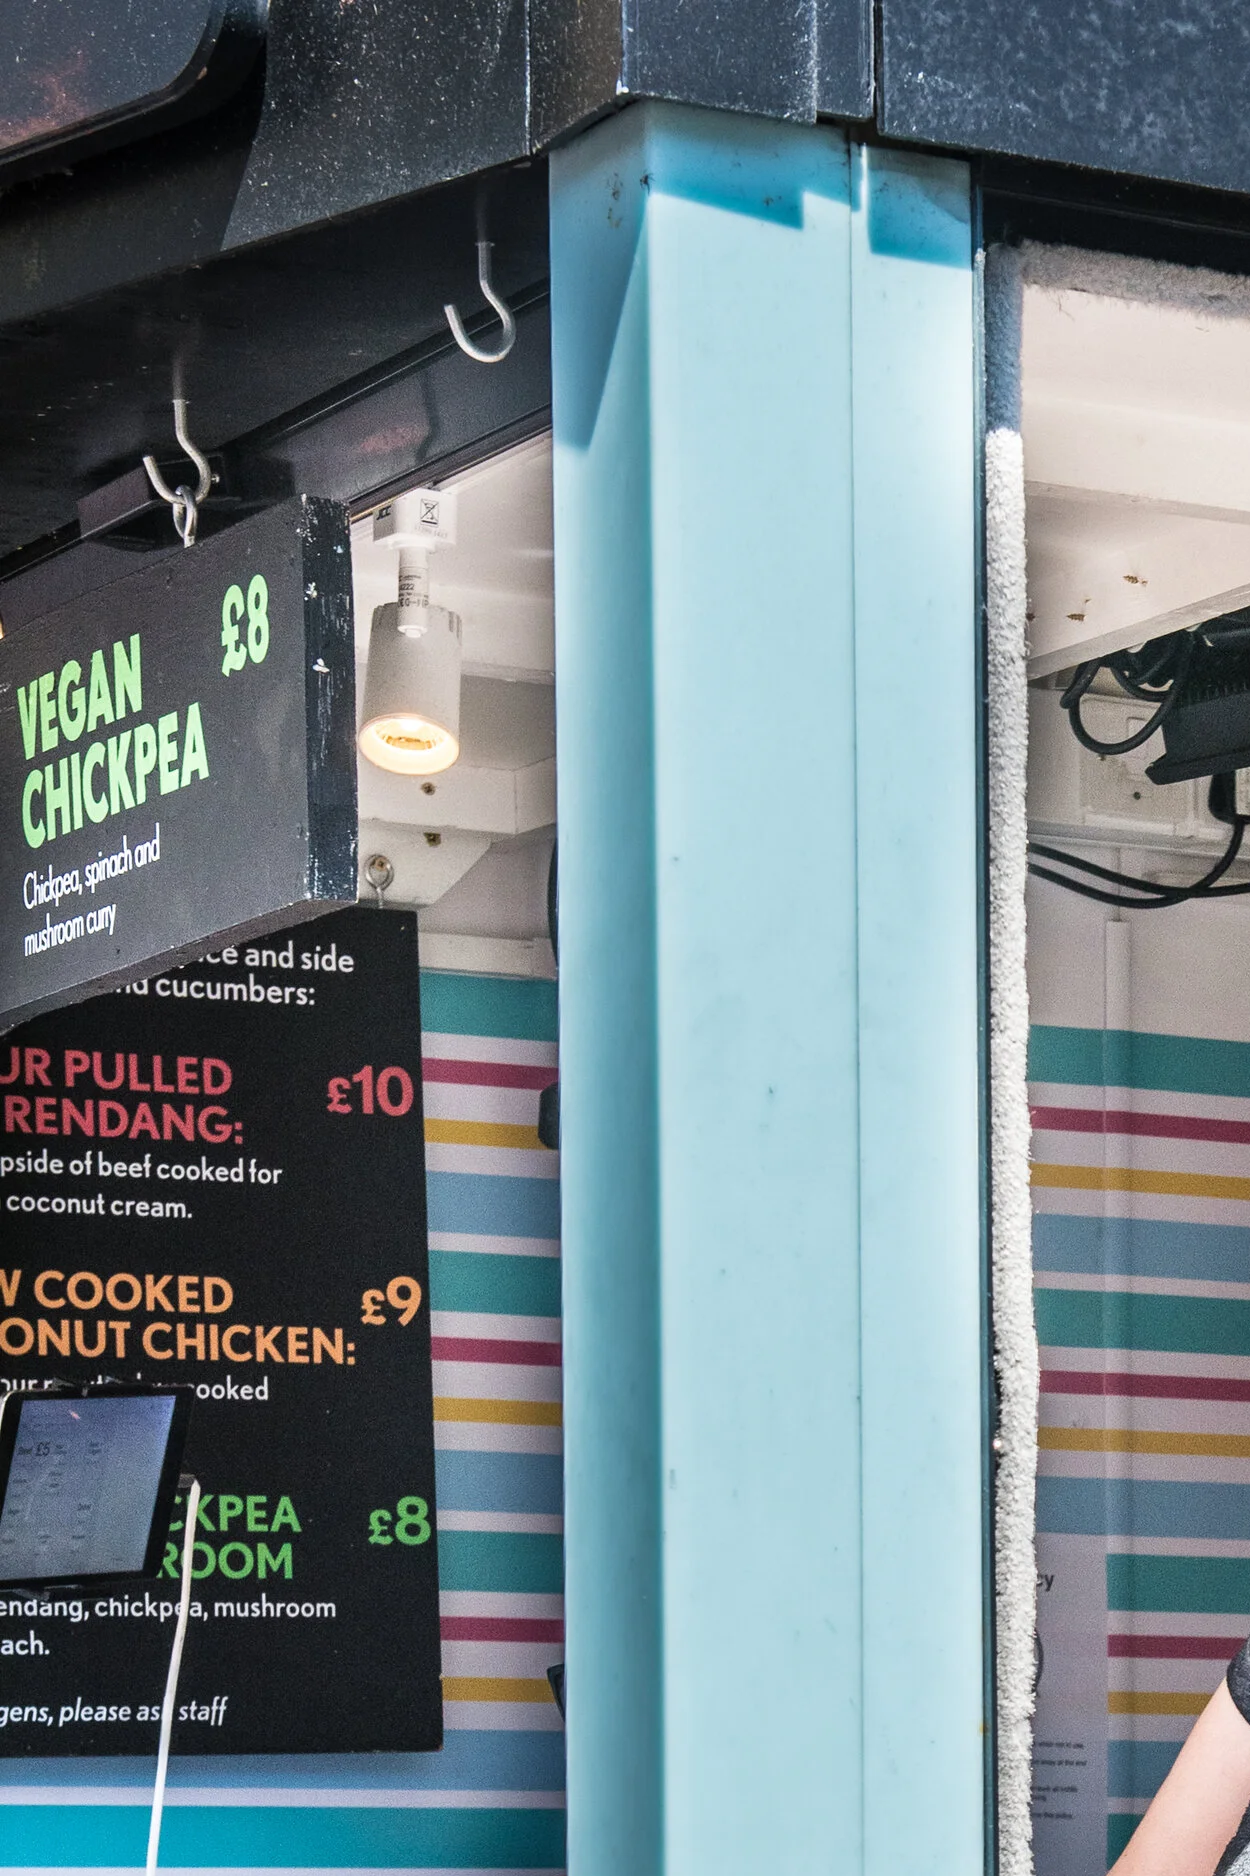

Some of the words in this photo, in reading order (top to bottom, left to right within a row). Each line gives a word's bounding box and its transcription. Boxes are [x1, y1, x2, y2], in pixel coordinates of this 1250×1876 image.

[221, 574, 269, 676] £8
[17, 634, 141, 760] VEGAN
[22, 703, 209, 849] CHICKPEA
[23, 864, 83, 910] Chickpea,
[84, 835, 133, 894] spinach
[134, 822, 160, 867] and
[24, 913, 84, 957] mushroom
[86, 904, 117, 936] curry
[244, 940, 293, 970] and
[301, 943, 354, 973] side
[155, 973, 315, 1006] cucumbers:
[64, 1050, 233, 1096] PULLED
[327, 1065, 415, 1117] £10
[5, 1097, 244, 1145] RENDANG:
[0, 1149, 64, 1177] pside
[69, 1150, 92, 1176] of
[98, 1151, 152, 1178] beef
[156, 1156, 244, 1183] cooked
[249, 1159, 283, 1185] for
[6, 1193, 105, 1215] coconut
[110, 1199, 193, 1219] cream.
[34, 1270, 234, 1314] COOKED
[361, 1276, 422, 1327] £9
[0, 1317, 131, 1359] ONUT
[142, 1322, 356, 1365] CHICKEN:
[188, 1374, 269, 1400] ooked
[368, 1496, 431, 1545] £8
[214, 1593, 337, 1618] mushroom
[0, 1630, 50, 1656] ach.
[59, 1697, 132, 1727] please
[178, 1696, 229, 1726] staff
